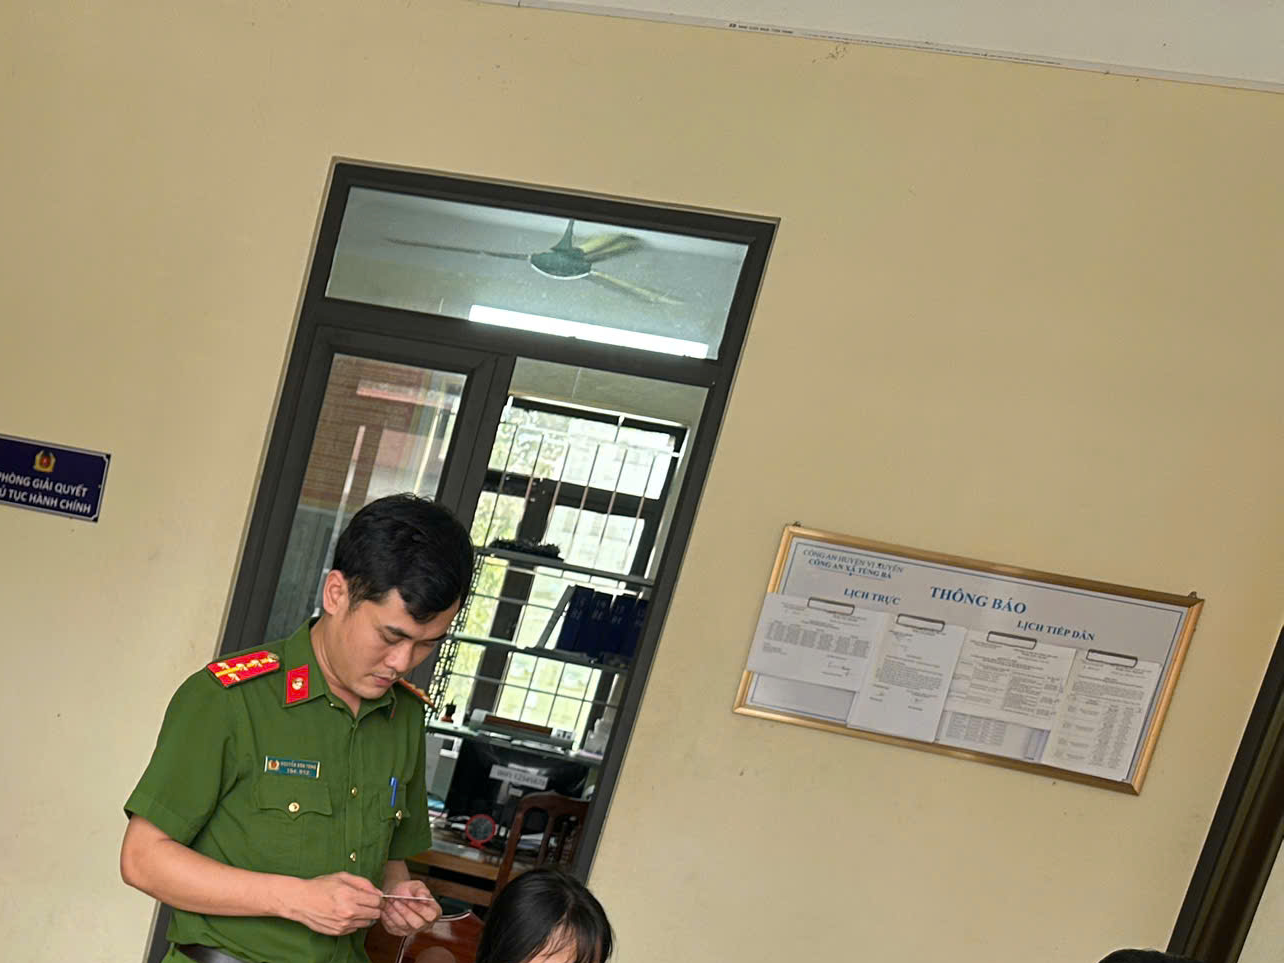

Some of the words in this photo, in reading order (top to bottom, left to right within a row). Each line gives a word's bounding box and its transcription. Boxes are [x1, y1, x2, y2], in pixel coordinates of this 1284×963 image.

[32, 477, 53, 491] GIẢI
[55, 483, 88, 498] QUYẾT
[9, 489, 28, 501] TỤC
[29, 491, 58, 507] HÀNH
[59, 498, 92, 514] CHÍNH
[844, 588, 869, 600] LỊCH
[872, 592, 901, 606] TRỰC
[930, 585, 988, 608] THÔNG
[991, 596, 1027, 615] BÁO
[1017, 619, 1045, 633] LỊCH
[1047, 622, 1073, 639] TIẾP
[1072, 628, 1096, 642] DÂN
